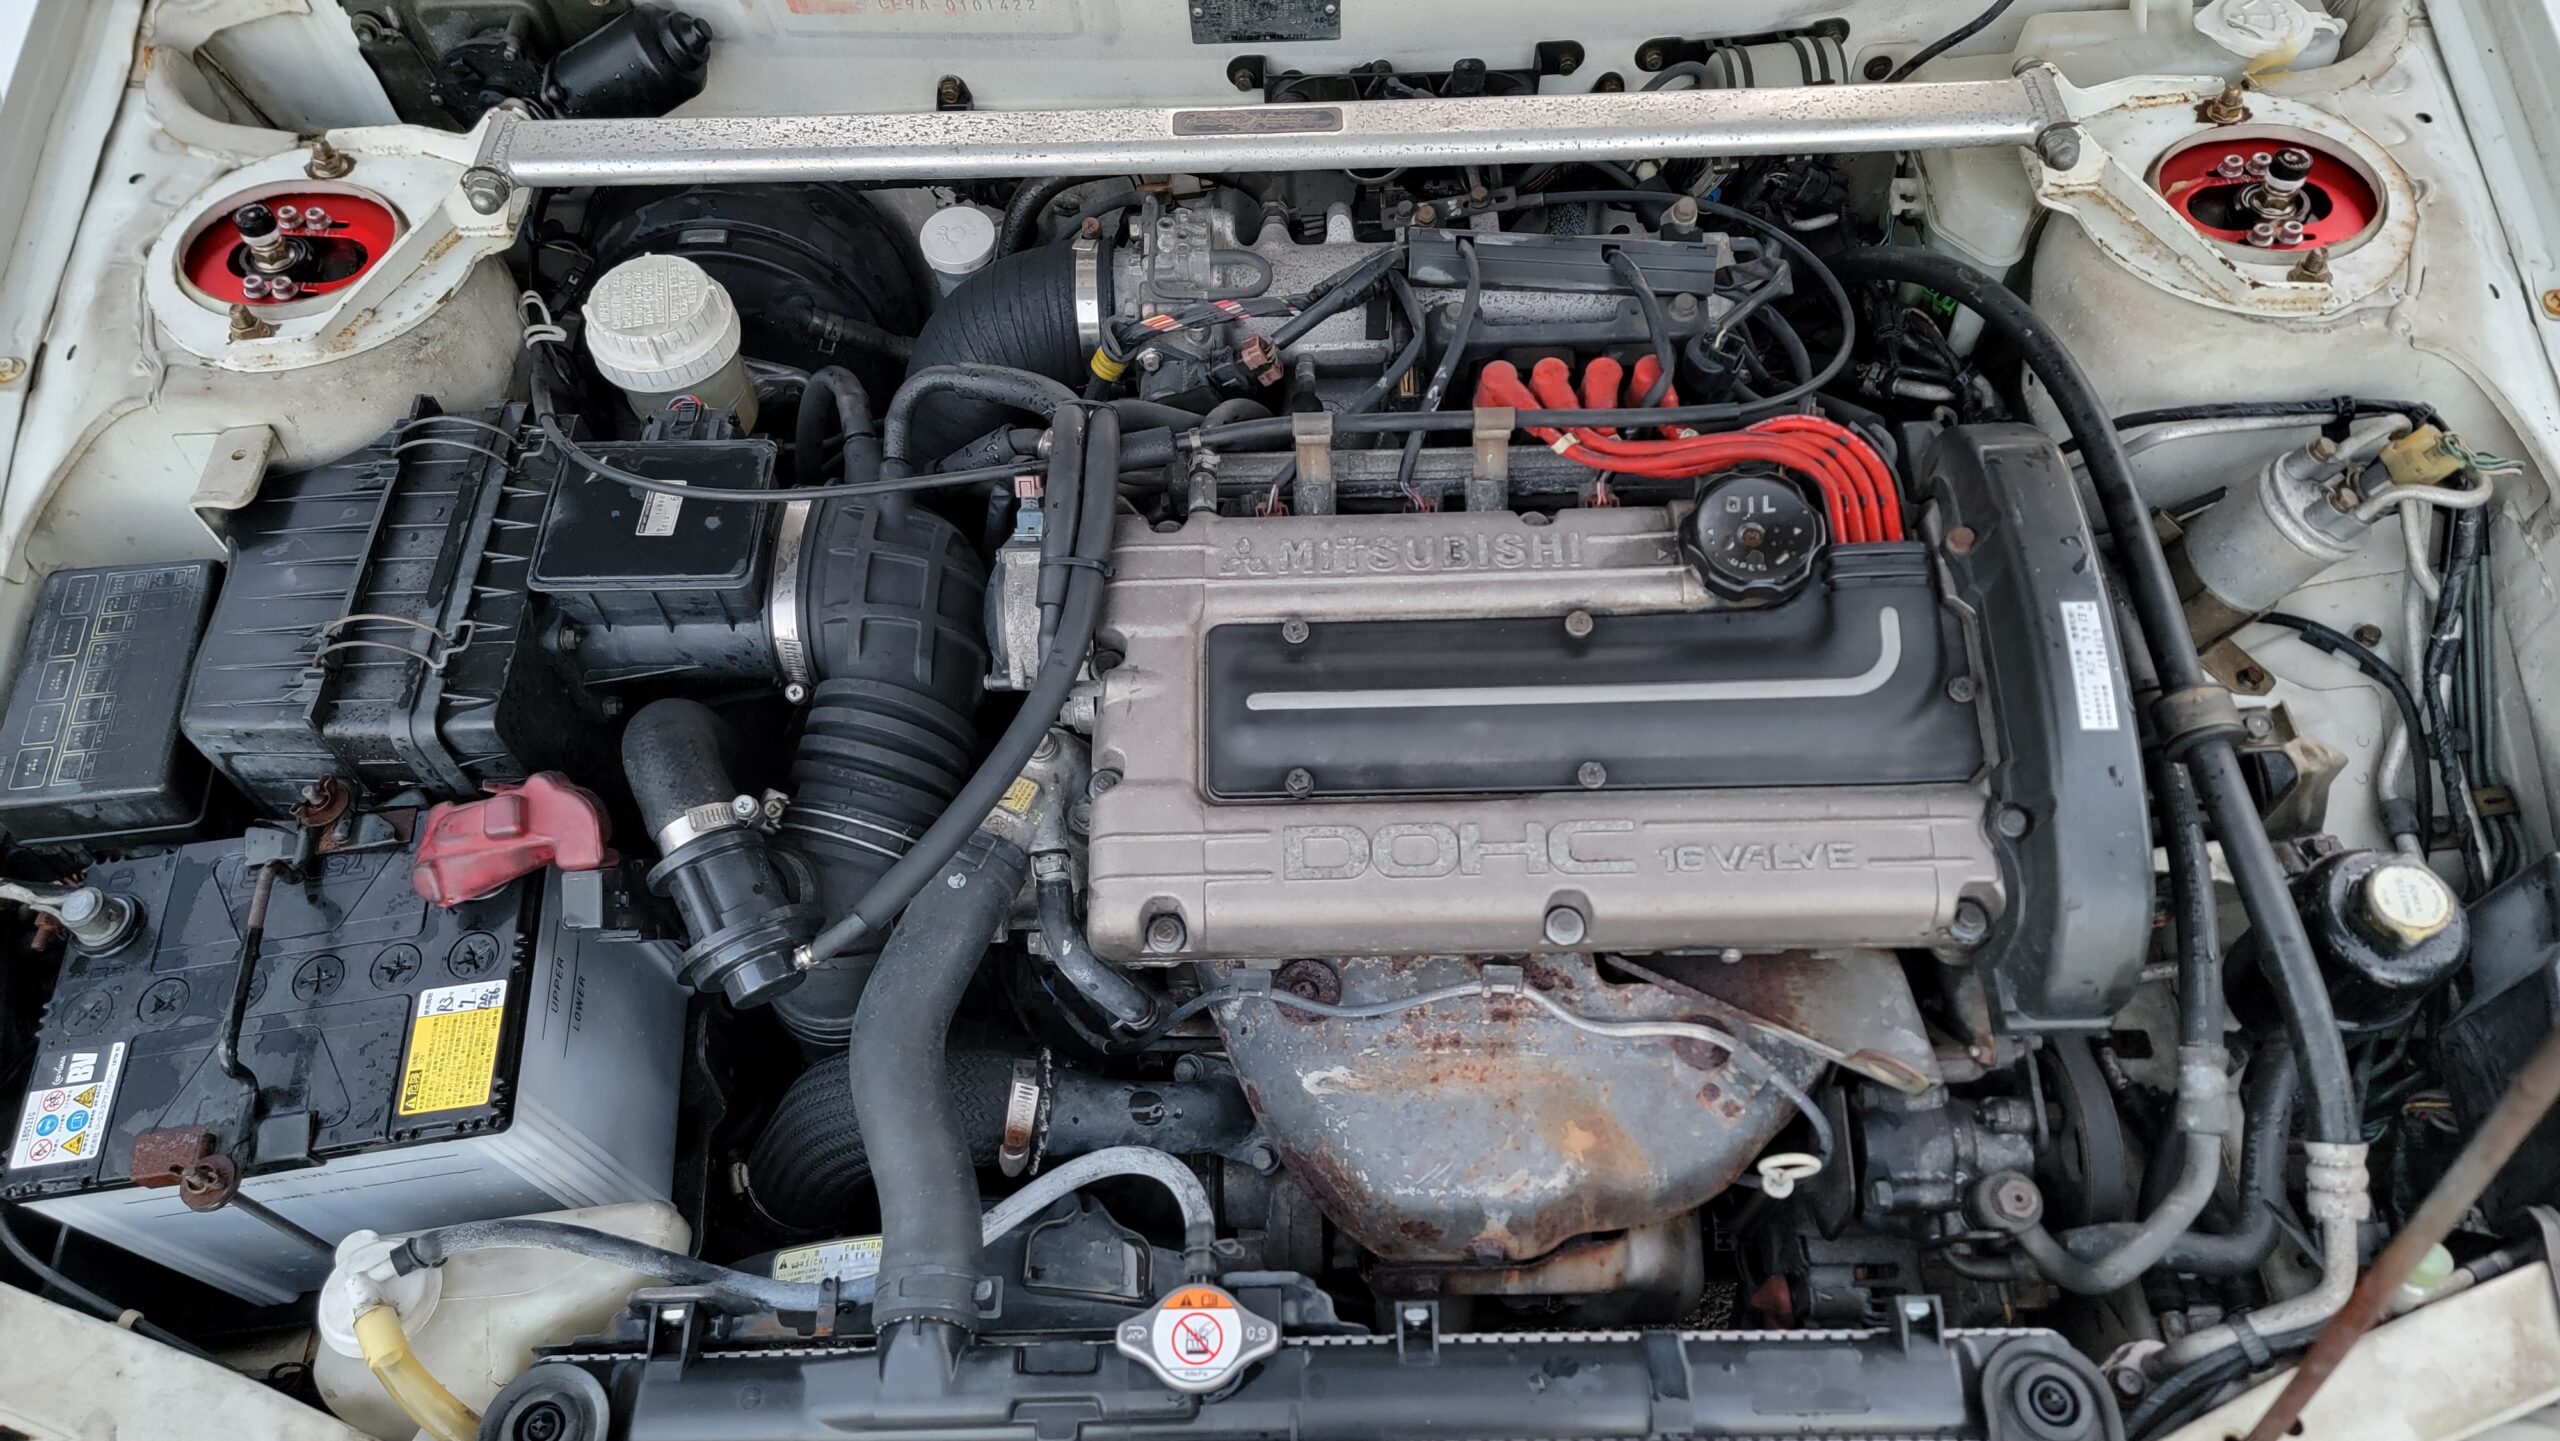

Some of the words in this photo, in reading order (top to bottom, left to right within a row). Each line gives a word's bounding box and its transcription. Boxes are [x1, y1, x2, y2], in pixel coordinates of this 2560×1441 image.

[1726, 495, 1776, 514] OIL
[1277, 532, 1584, 574] MITSUBISHI
[1283, 818, 1635, 881] DOHC
[551, 956, 564, 1013] UPPER
[573, 975, 586, 1032] LOWER
[66, 1053, 98, 1083] BV
[408, 1071, 421, 1096] 危険
[247, 1178, 286, 1187] UPPER
[293, 1172, 331, 1181] LEVEL
[321, 1186, 358, 1195] LEVEL
[845, 1241, 882, 1251] CAUTION
